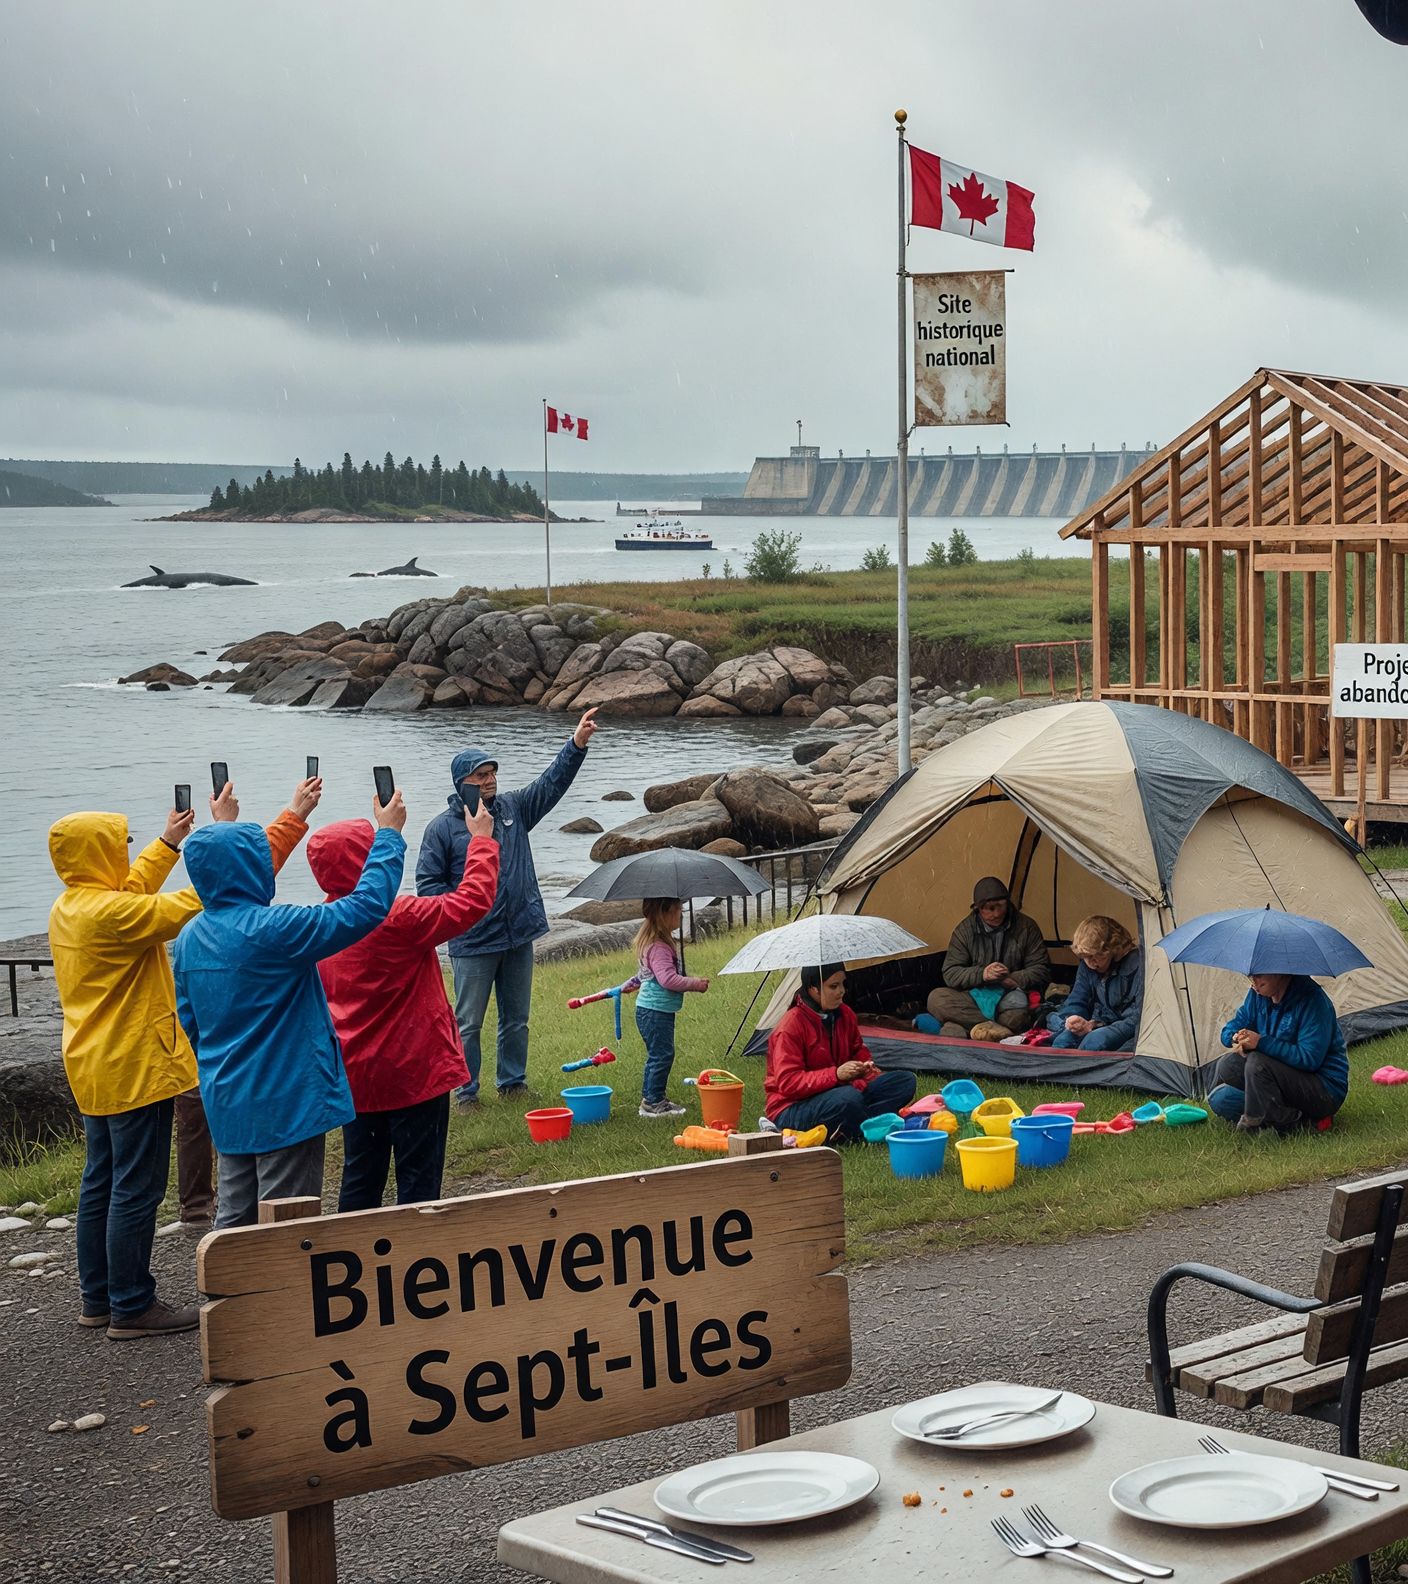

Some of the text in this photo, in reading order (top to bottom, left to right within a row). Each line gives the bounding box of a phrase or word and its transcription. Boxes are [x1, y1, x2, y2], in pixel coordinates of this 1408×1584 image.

[937, 293, 972, 314] Site
[917, 320, 1004, 345] historique
[925, 344, 996, 368] national
[309, 1208, 754, 1338] Bienvenue
[322, 1288, 773, 1454] à Sept-Îles
